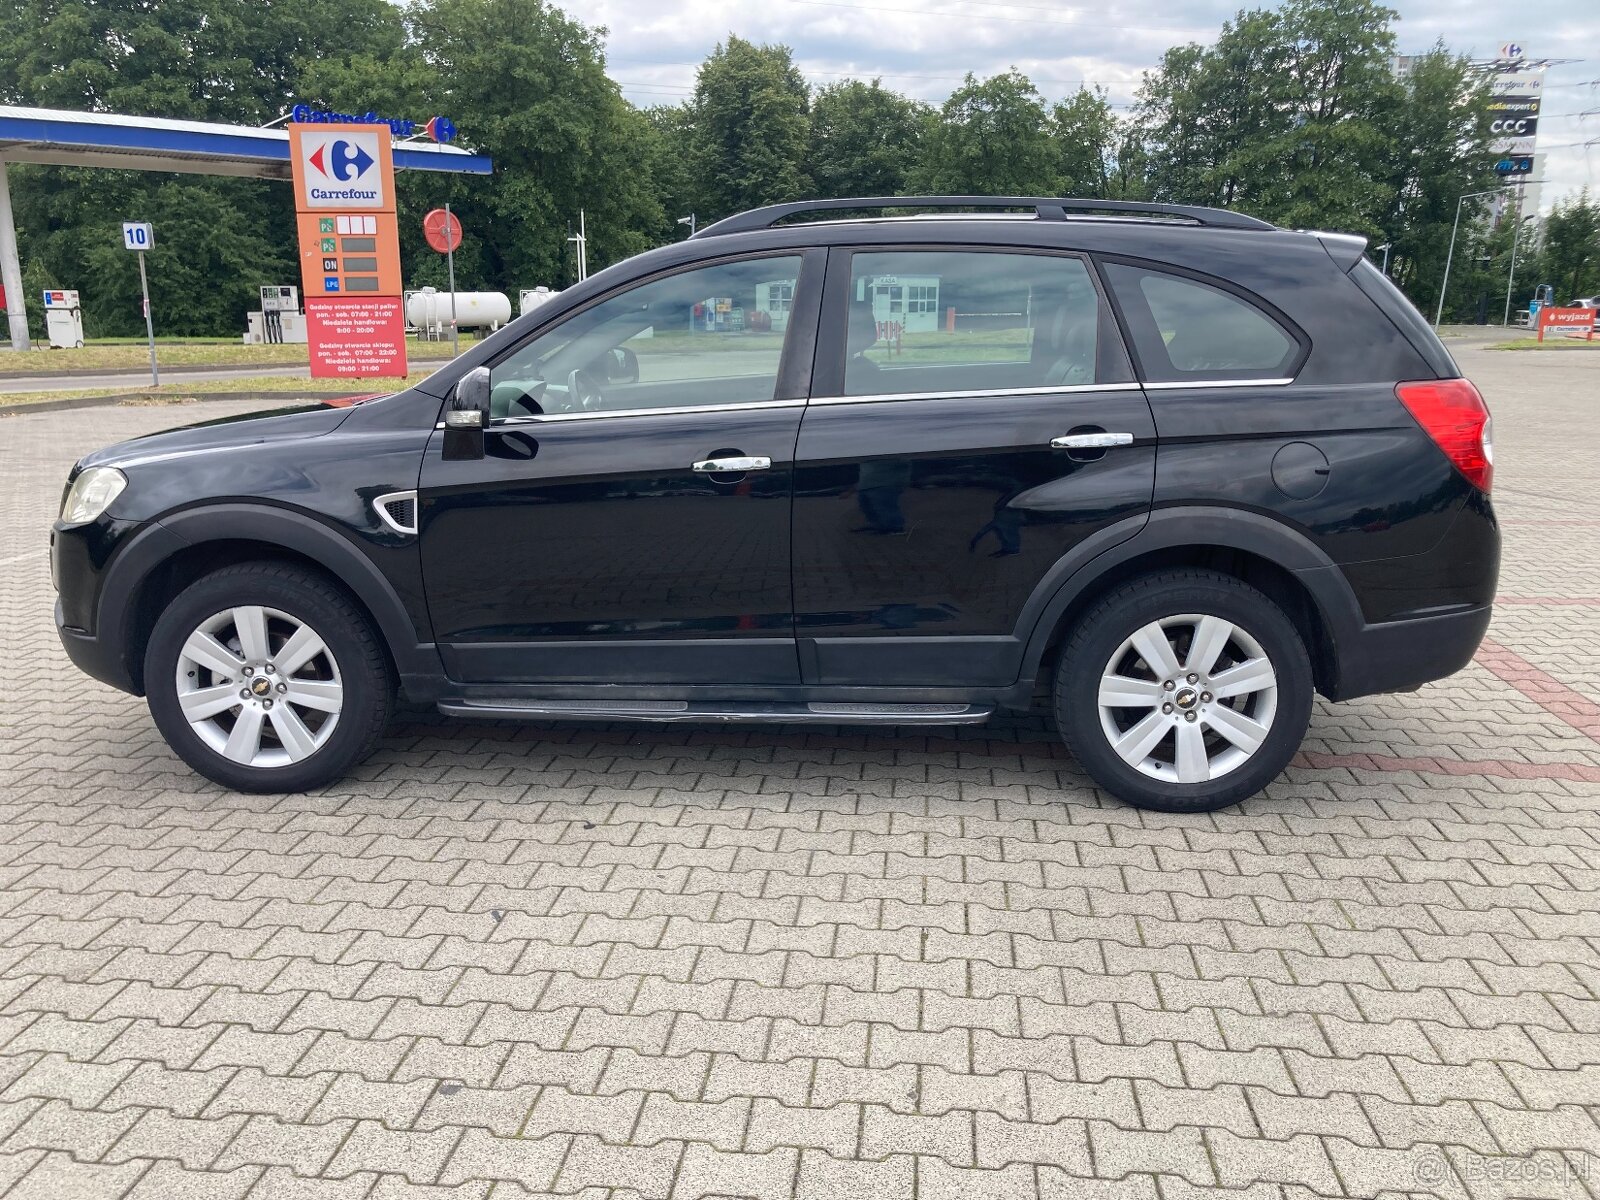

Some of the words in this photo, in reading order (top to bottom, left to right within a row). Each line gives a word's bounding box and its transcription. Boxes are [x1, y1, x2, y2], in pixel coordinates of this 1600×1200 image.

[1490, 120, 1527, 133] CCC
[311, 189, 376, 199] Carrefour
[126, 228, 146, 245] 10
[324, 261, 337, 270] ON
[1558, 313, 1590, 322] wyjazd
